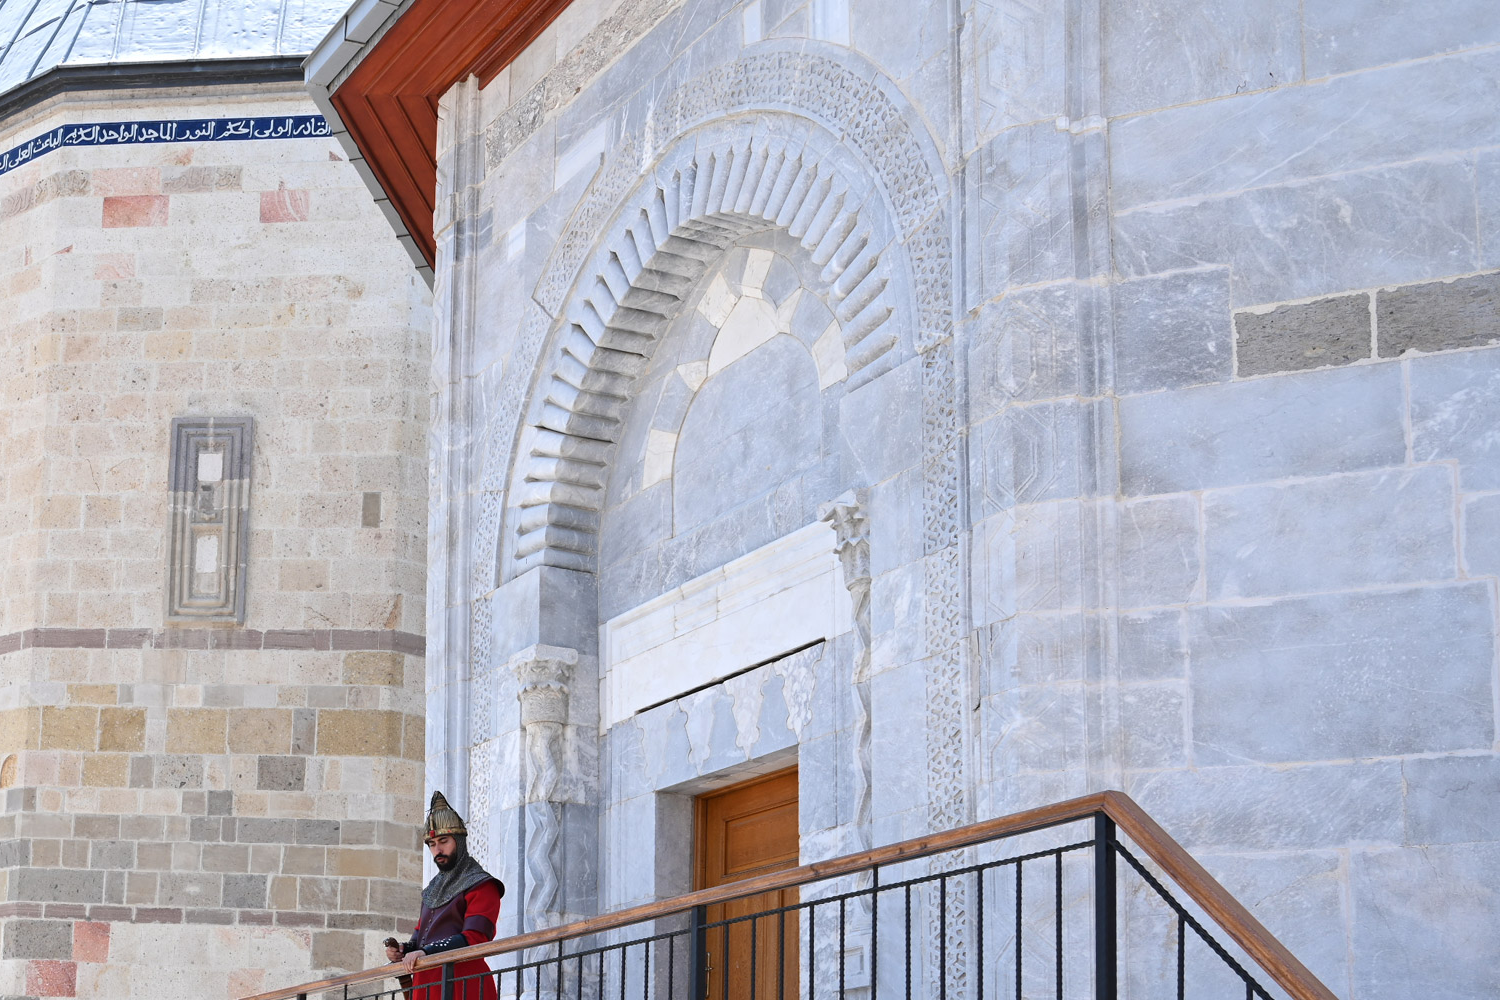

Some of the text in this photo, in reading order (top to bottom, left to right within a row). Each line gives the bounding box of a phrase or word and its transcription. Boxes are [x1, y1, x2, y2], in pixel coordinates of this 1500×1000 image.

[63, 125, 100, 144] الكريم
[99, 123, 138, 142] الواحد
[138, 122, 177, 141] الماجد
[177, 121, 216, 139] النور
[33, 128, 63, 153] الباعث
